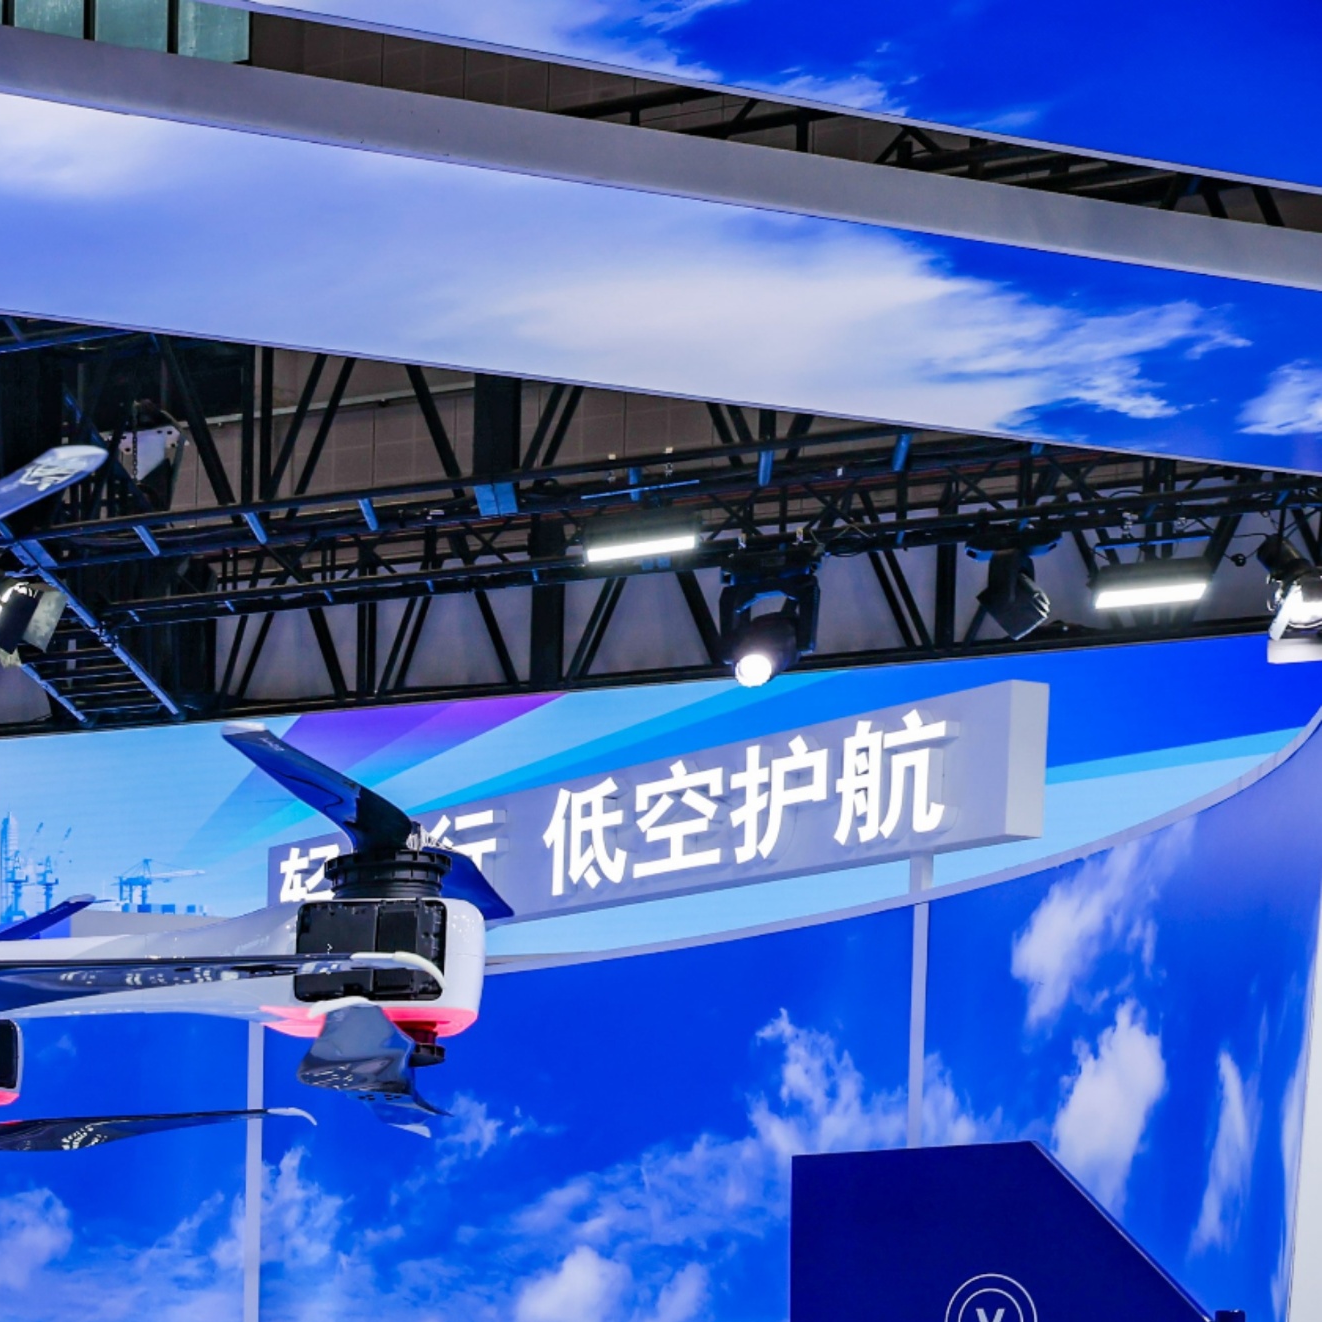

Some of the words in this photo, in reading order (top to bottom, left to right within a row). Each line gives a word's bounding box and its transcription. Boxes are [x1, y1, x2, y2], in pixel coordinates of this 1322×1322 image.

[279, 809, 498, 902] 轻行
[543, 709, 947, 896] 低空护航
